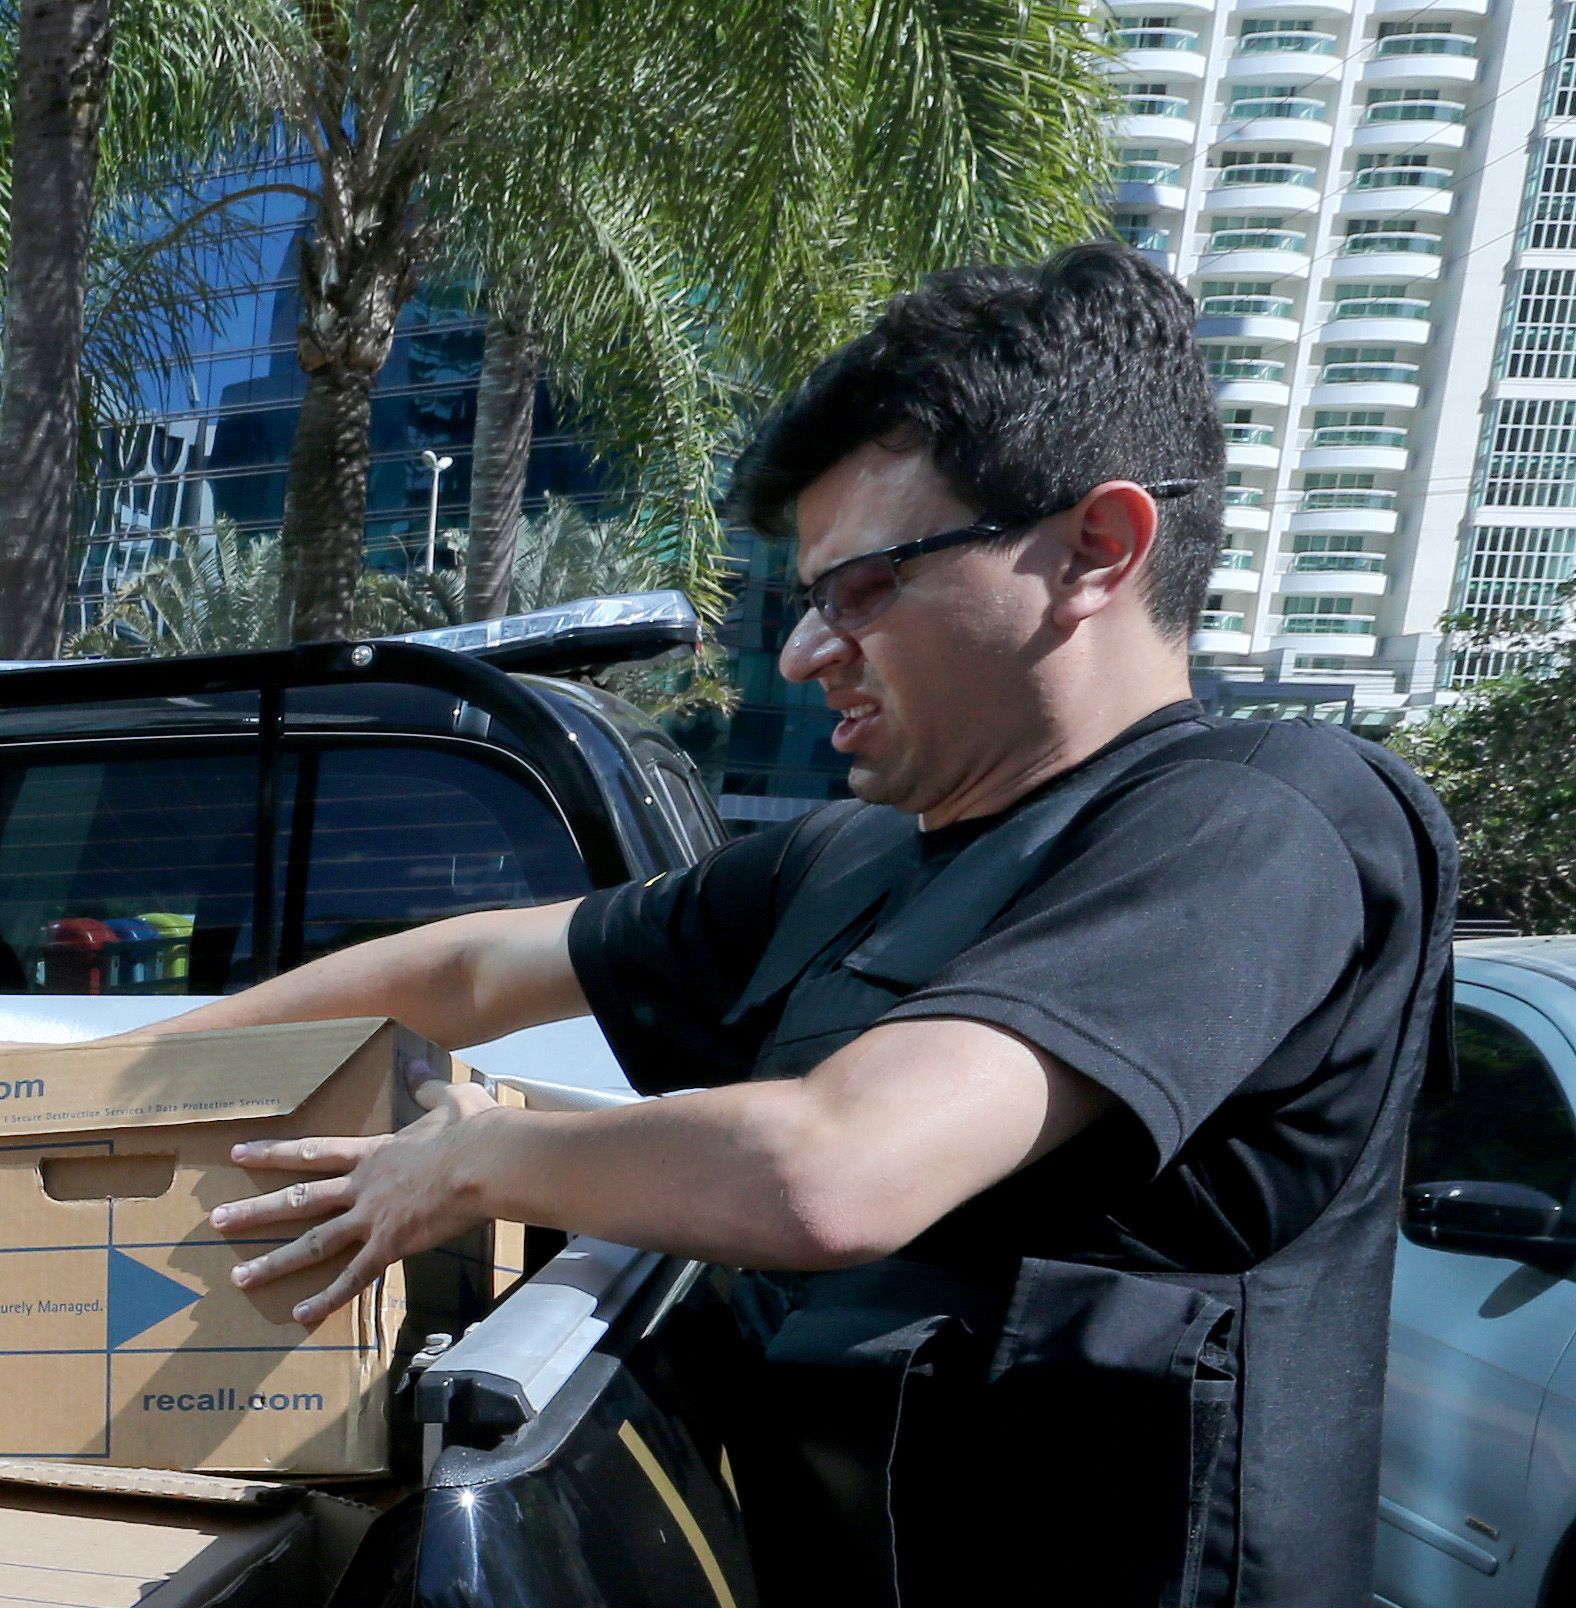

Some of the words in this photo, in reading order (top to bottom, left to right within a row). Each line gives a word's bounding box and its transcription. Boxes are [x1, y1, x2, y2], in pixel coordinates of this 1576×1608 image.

[11, 1112, 43, 1123] Secure
[46, 1108, 101, 1121] Destruction
[104, 1105, 145, 1117] Services
[155, 1103, 178, 1113] Data
[182, 1099, 235, 1112] Protection
[37, 1299, 104, 1316] Managed.
[143, 1387, 324, 1412] recall.com
